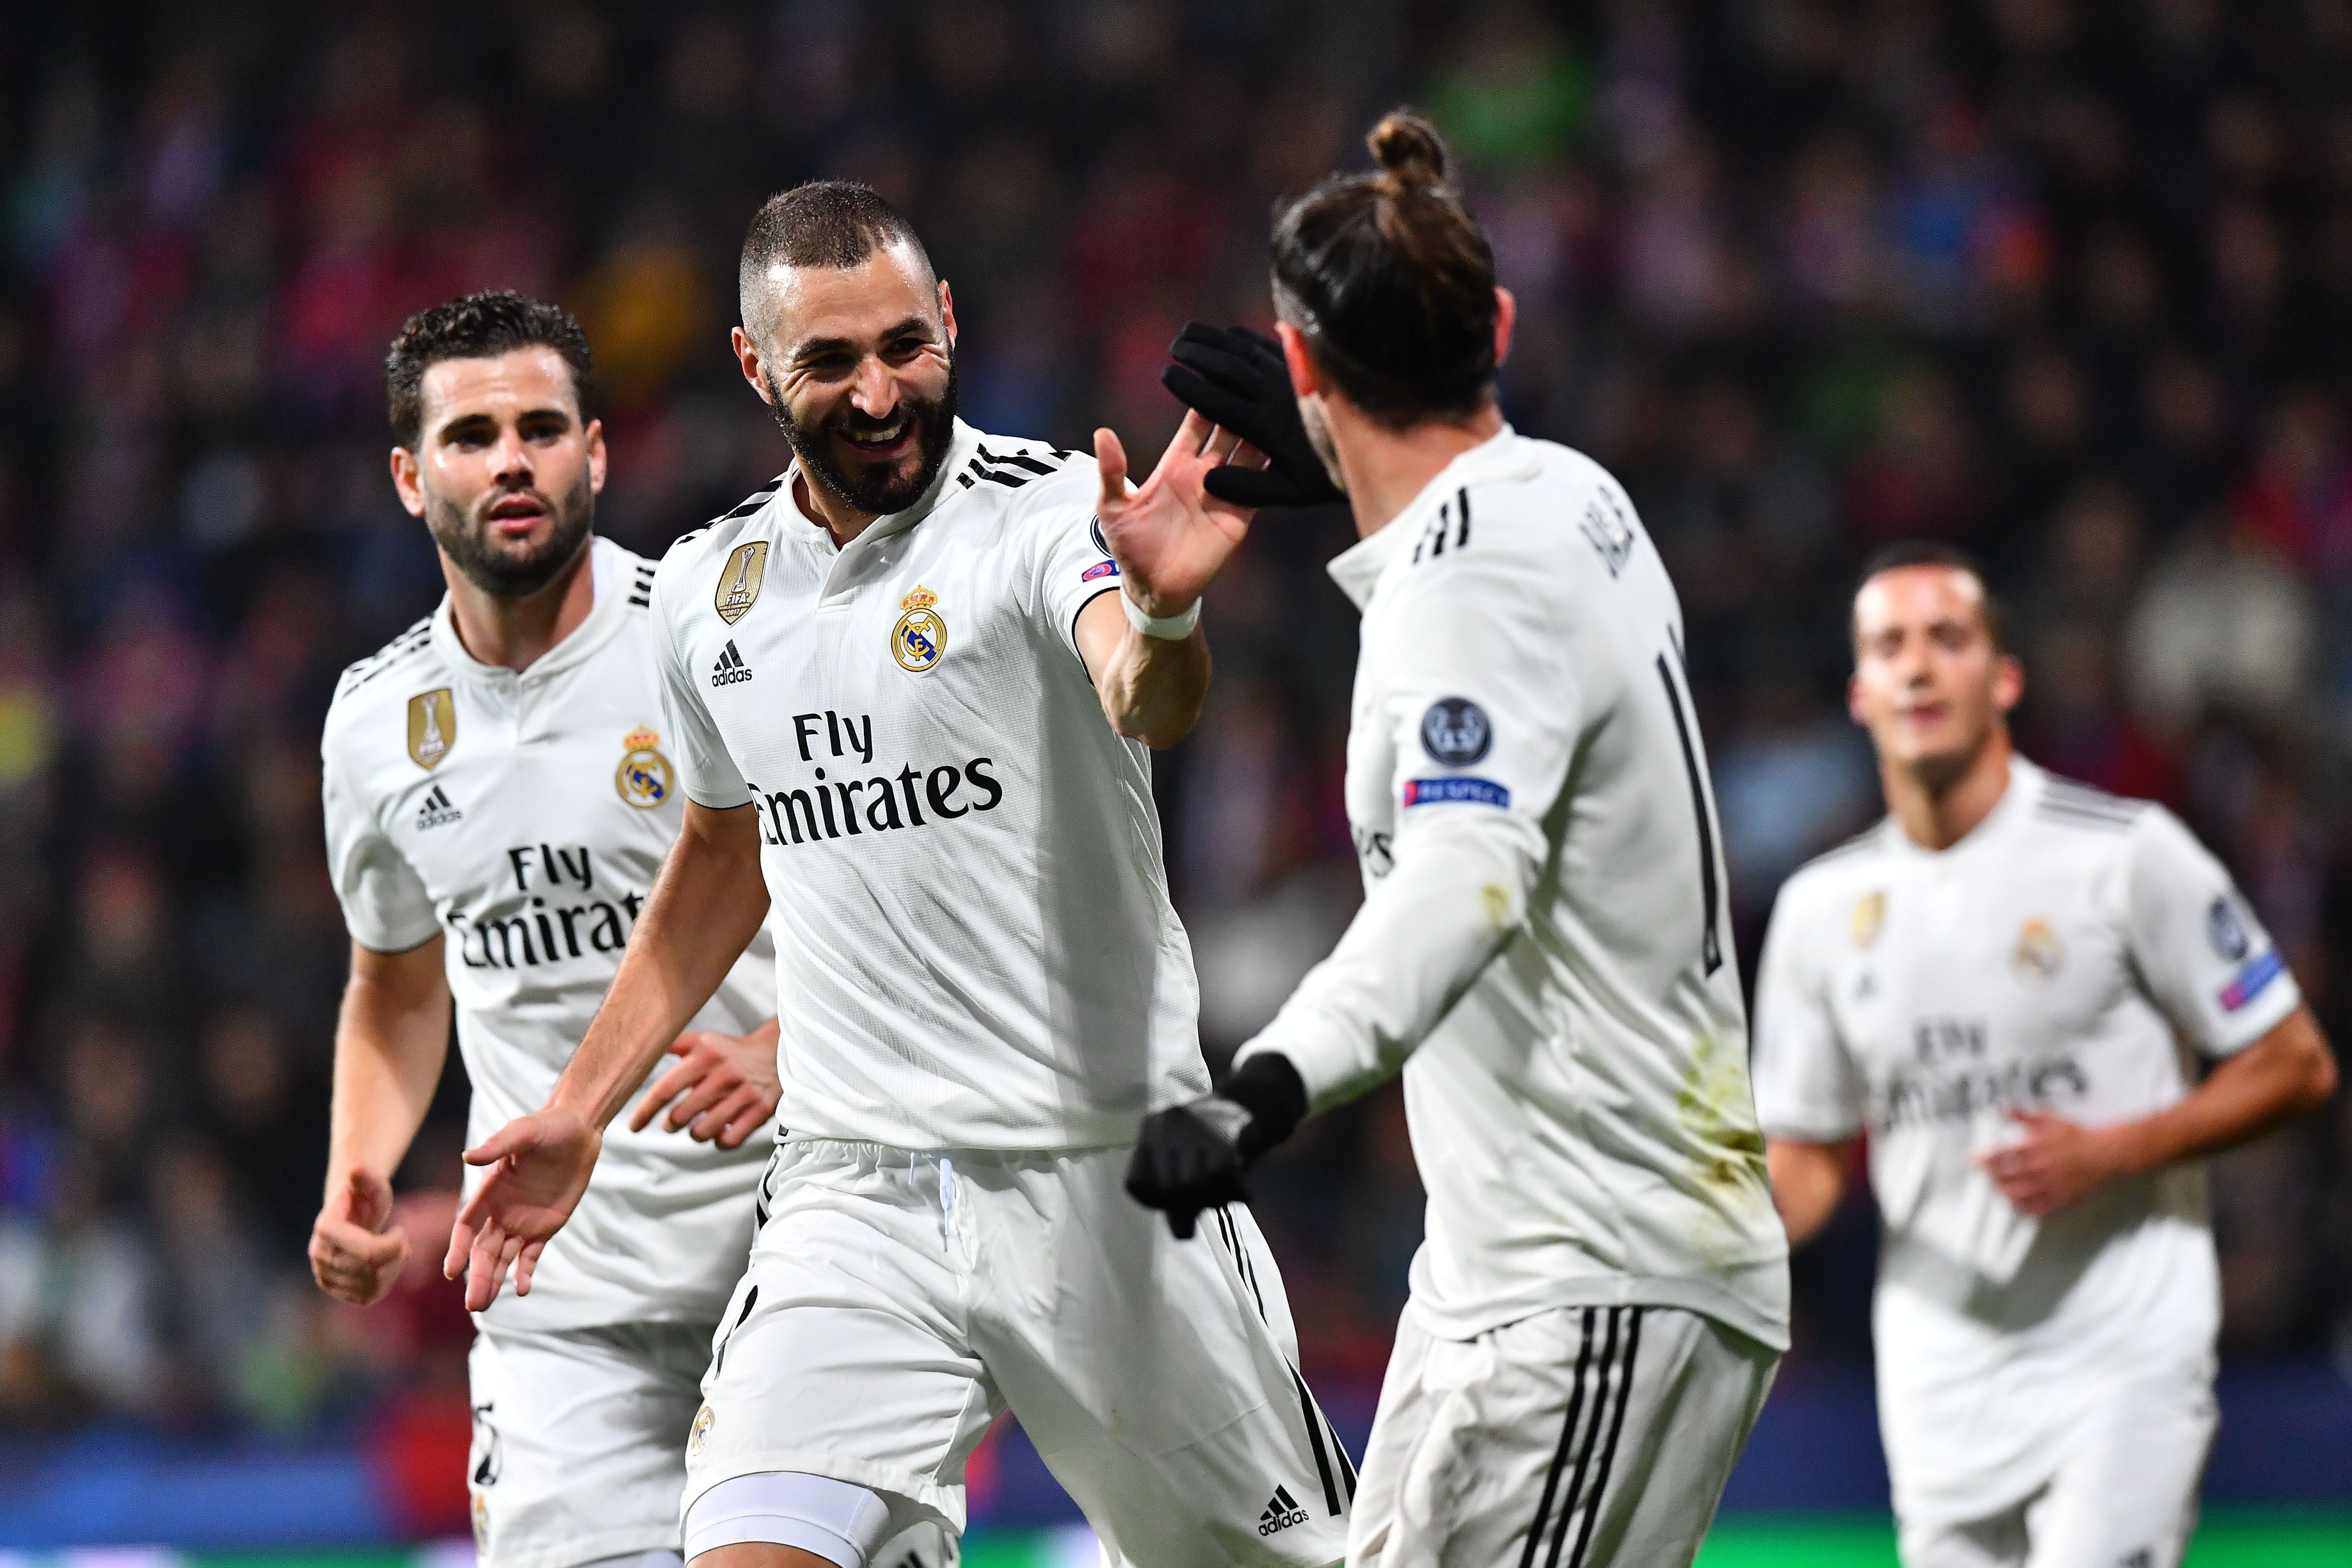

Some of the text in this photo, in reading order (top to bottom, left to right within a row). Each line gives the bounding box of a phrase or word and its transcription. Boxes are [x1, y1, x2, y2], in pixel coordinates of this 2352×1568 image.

[726, 593, 747, 605] FIFA
[712, 667, 753, 687] adidas
[792, 710, 873, 764] Fly
[509, 844, 592, 890] Fly
[447, 892, 643, 969] Emirat
[1258, 1509, 1309, 1537] adidas
